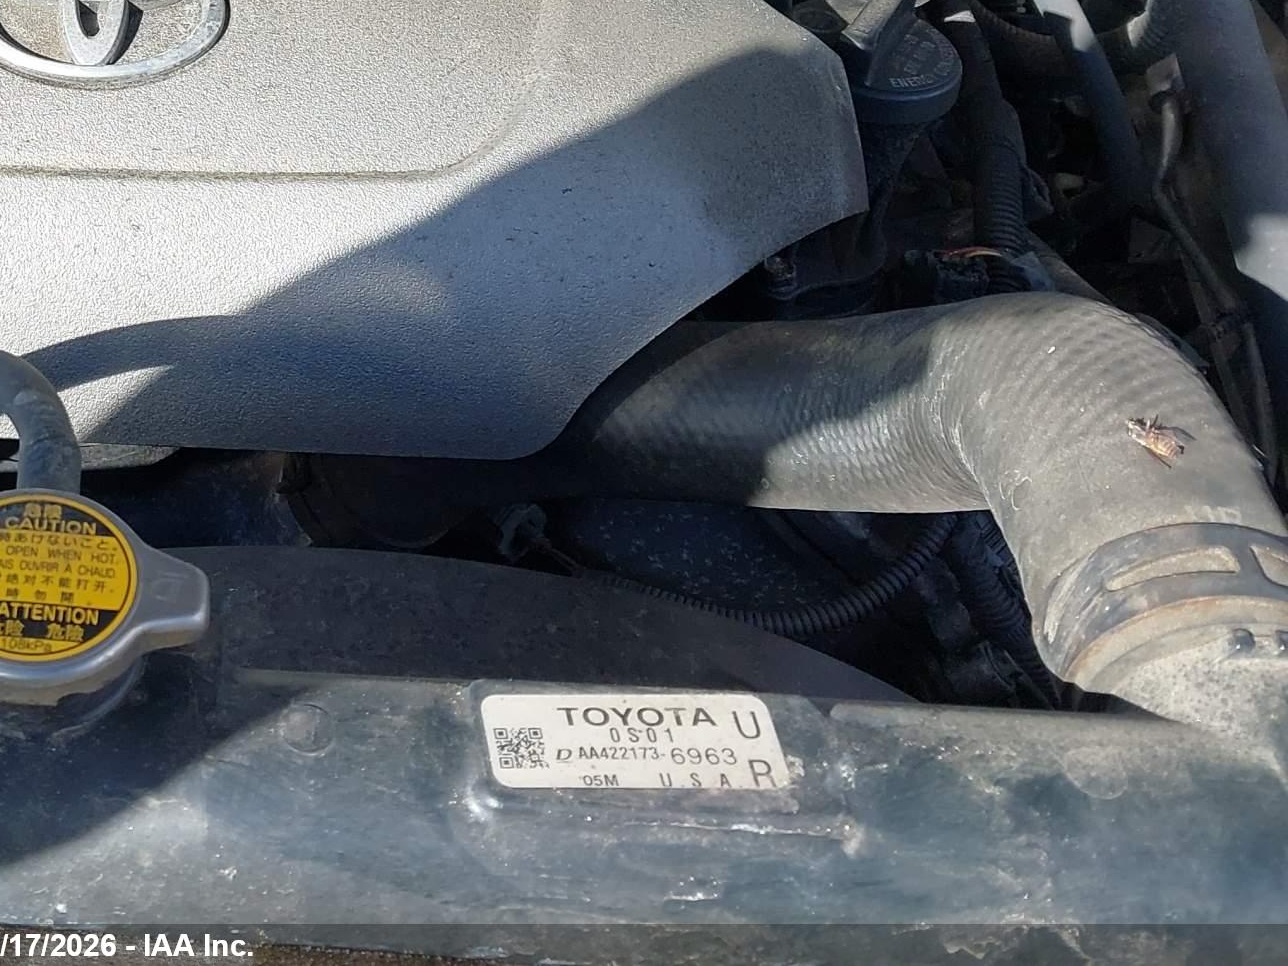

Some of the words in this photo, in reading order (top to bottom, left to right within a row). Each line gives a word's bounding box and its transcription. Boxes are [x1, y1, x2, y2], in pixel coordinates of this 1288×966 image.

[5, 517, 97, 535] CAUTION
[6, 546, 39, 557] OPEN
[48, 548, 82, 561] WHEN
[556, 707, 718, 727] TOYOTA
[732, 710, 762, 739] U
[748, 759, 777, 787] R
